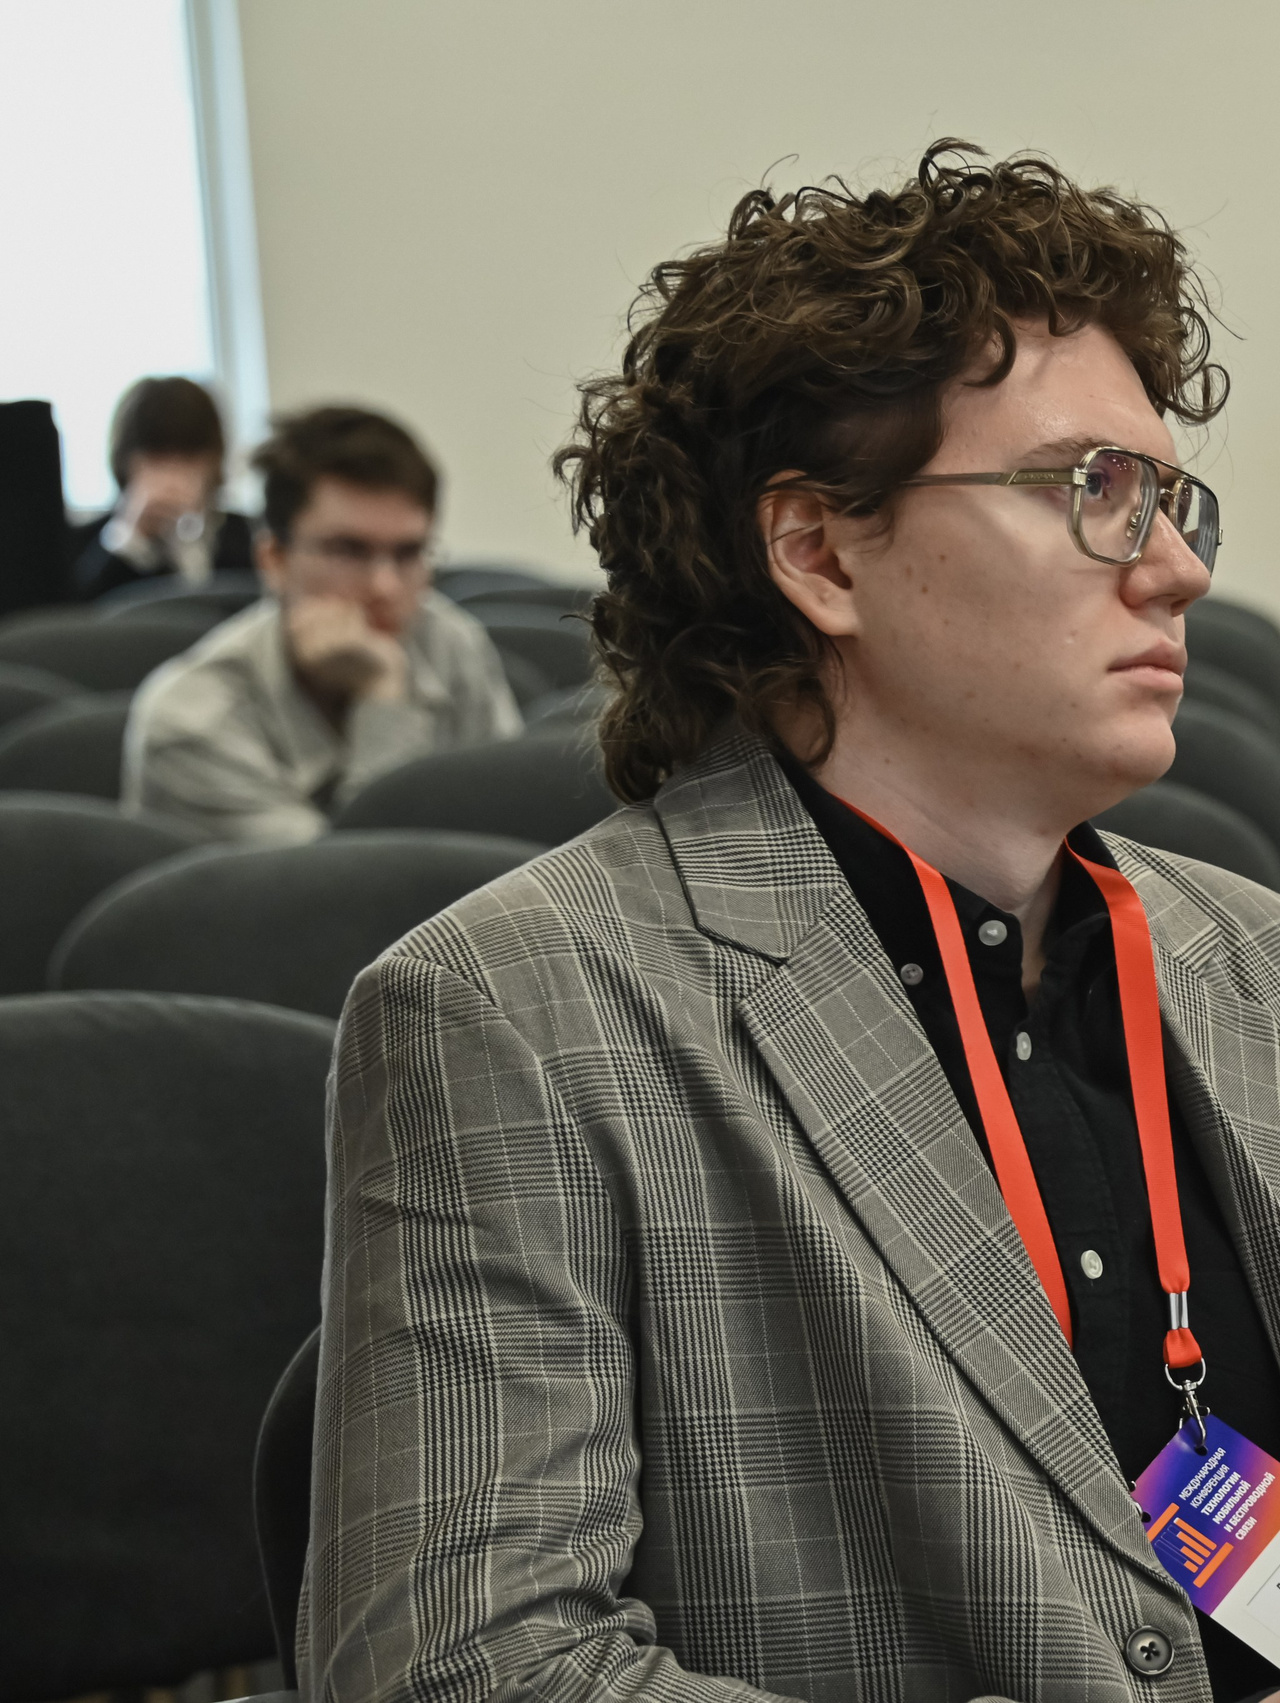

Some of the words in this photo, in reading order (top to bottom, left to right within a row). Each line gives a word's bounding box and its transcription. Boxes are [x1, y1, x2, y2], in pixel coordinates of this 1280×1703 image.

[1179, 1447, 1227, 1500] МЕЖДУНАРОДНАЯ
[1190, 1464, 1230, 1508] КОНФЕРЕНЦИЯ
[1201, 1471, 1241, 1516] ТЕХНОЛОГИИ
[1212, 1480, 1251, 1524] МОБИЛЬНОЙ
[1223, 1523, 1234, 1533] И
[1229, 1472, 1275, 1527] БЕСПРОВОДНОЙ
[1235, 1516, 1257, 1540] СВЯЗИ
